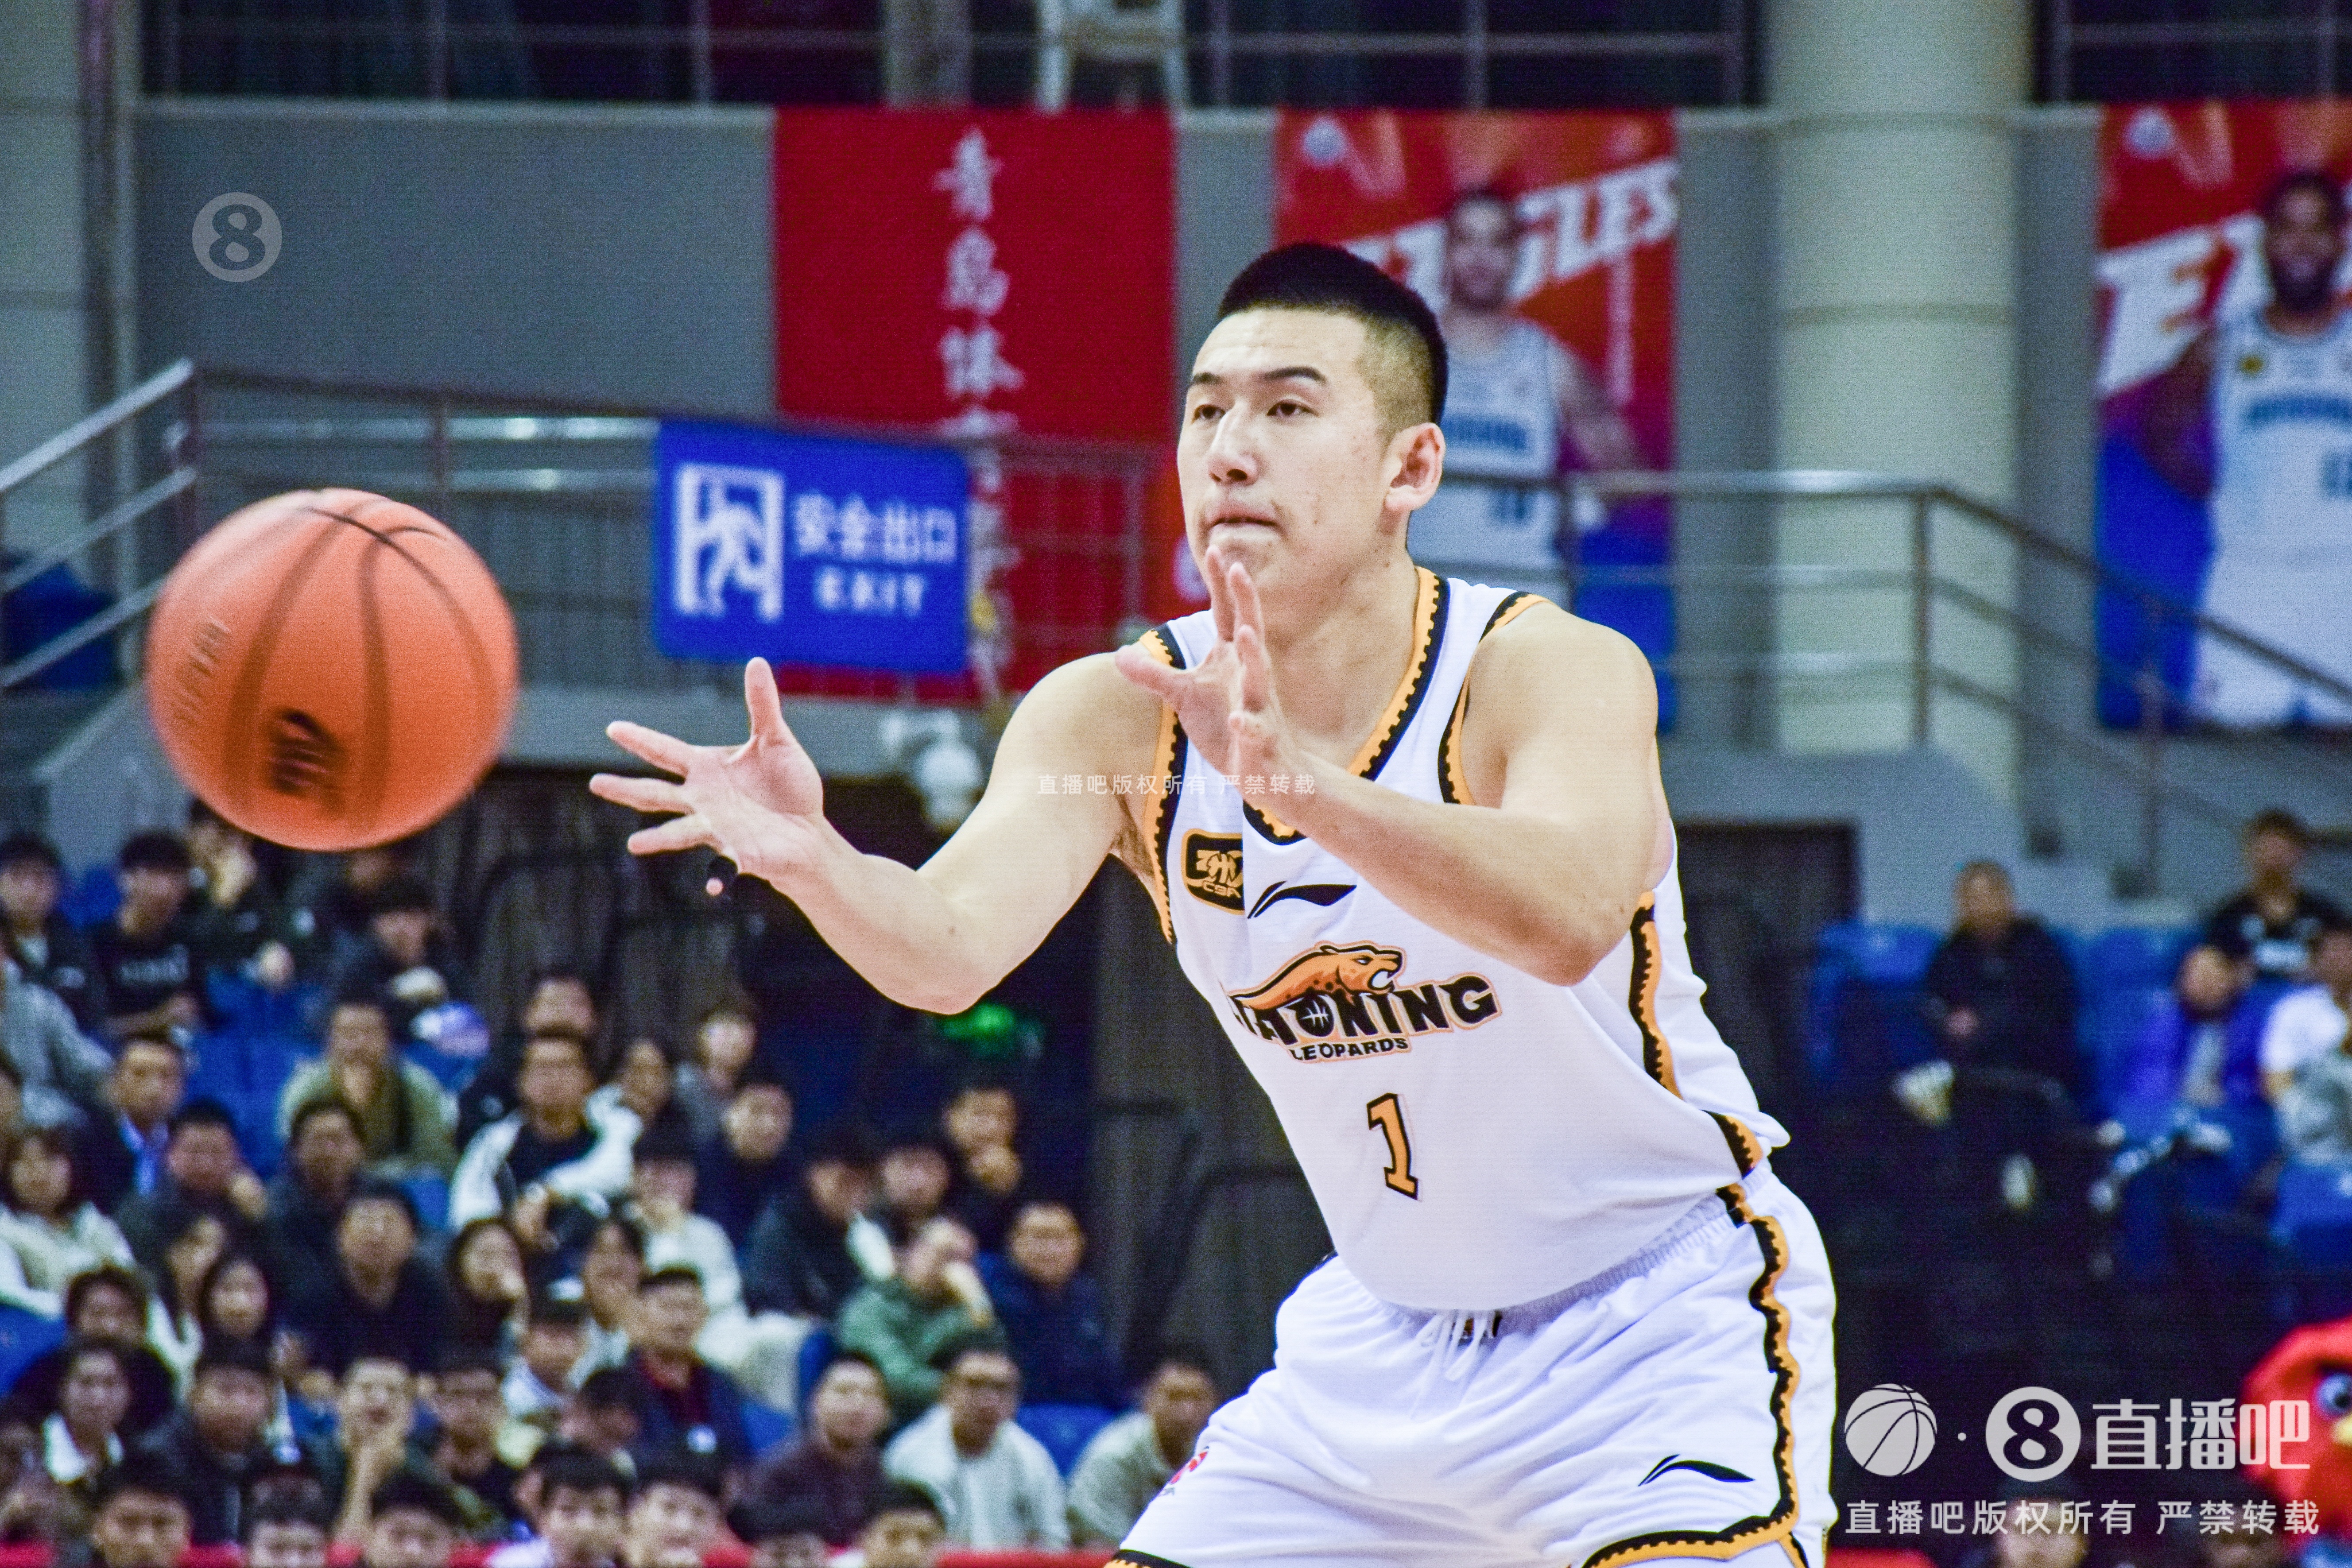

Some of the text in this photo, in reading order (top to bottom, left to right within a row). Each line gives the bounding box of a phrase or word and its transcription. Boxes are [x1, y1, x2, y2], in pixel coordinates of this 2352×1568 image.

[795, 490, 957, 563] 安全出口
[816, 566, 926, 616] EXIT
[1289, 1037, 1409, 1061] LEOPARDS
[1366, 1093, 1419, 1201] 1
